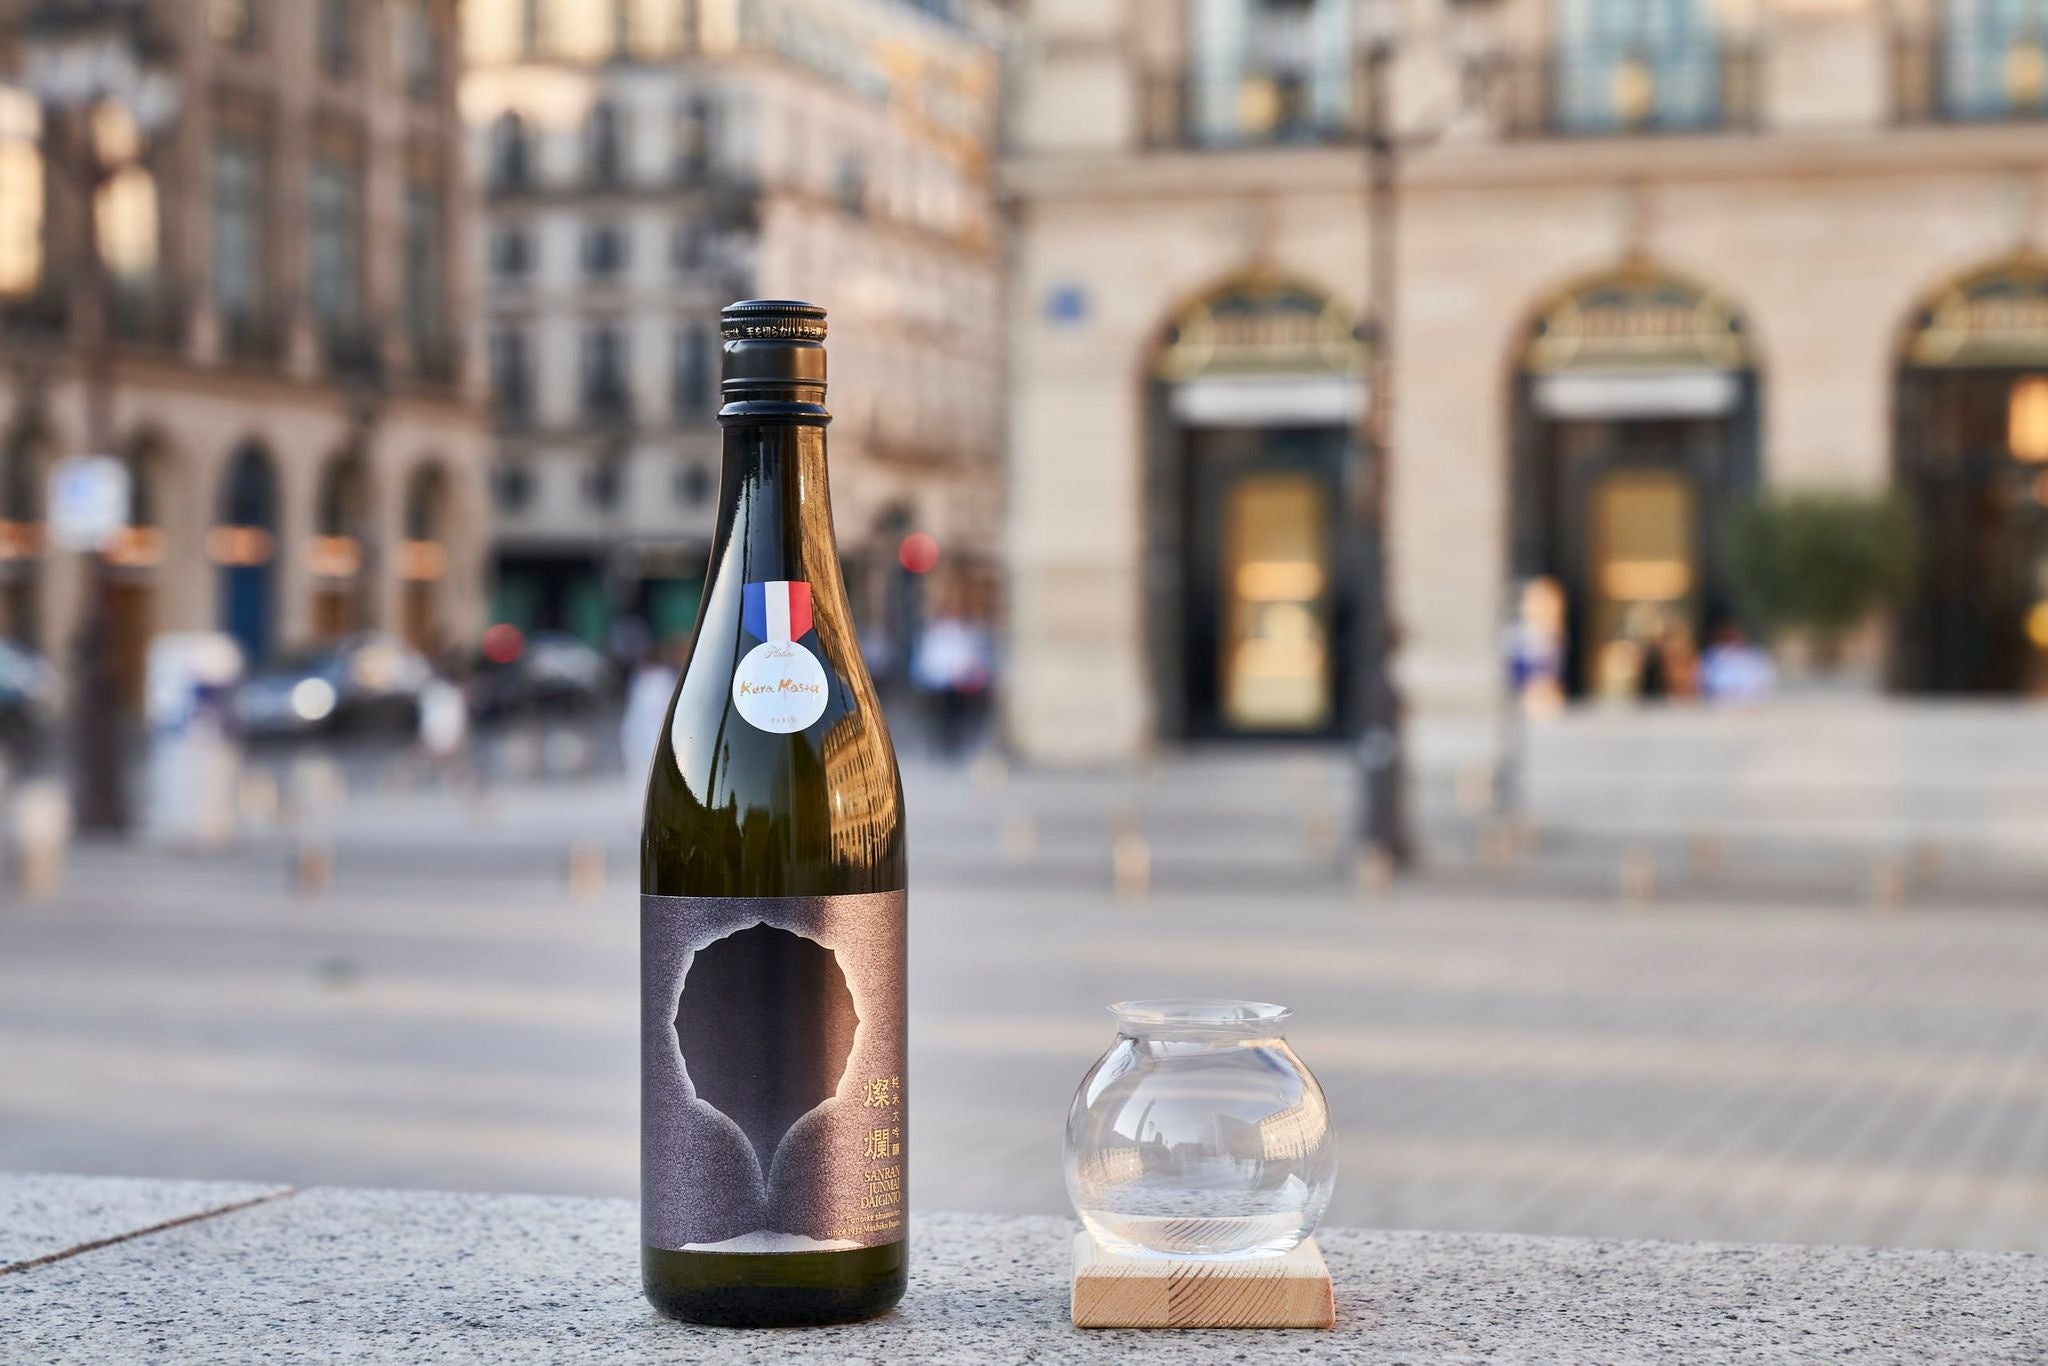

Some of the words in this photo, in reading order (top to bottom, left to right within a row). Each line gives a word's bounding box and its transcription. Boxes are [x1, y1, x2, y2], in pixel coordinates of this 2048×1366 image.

[863, 1078, 890, 1160] 燦爛
[864, 1165, 901, 1183] SANRAN
[868, 1178, 901, 1198] JUNMAI
[860, 1191, 901, 1209] DAIGINJO
